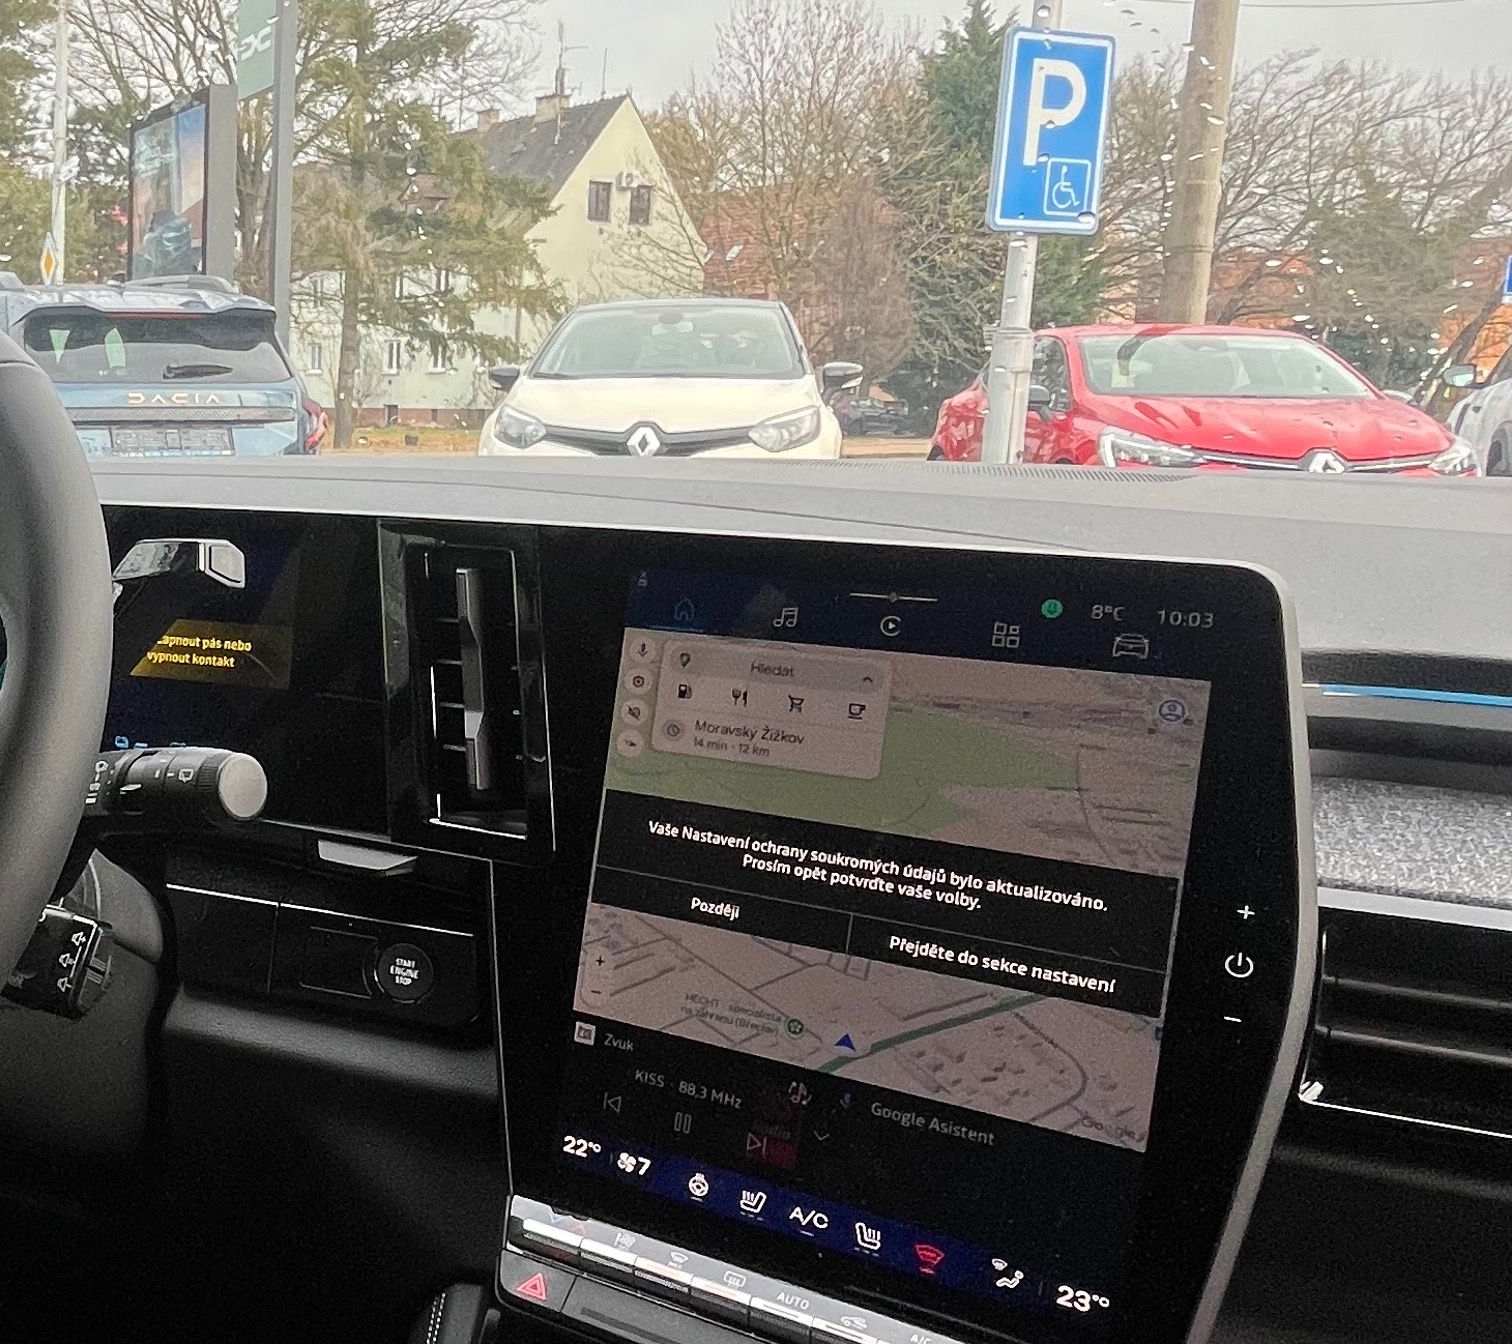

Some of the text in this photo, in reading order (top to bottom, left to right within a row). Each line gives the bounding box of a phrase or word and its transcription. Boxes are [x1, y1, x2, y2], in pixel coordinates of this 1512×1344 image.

[1023, 58, 1087, 166] P
[127, 392, 220, 405] DACIA
[1157, 608, 1214, 628] 10:03
[157, 634, 253, 653] apnout pás nebo
[146, 650, 236, 668] vypnout kontakt
[750, 661, 795, 678] Hledat
[752, 744, 770, 757] km
[648, 819, 1108, 912] Vaše Nastavení ochrany soukromých údajů bylo aktualizováno.
[742, 853, 982, 911] Prosím opět potvrďte vaše volby.
[690, 896, 740, 922] Později
[889, 934, 1117, 994] Přejděte do sekce nastavení
[603, 1032, 635, 1052] Zvuk
[634, 1068, 666, 1089] KISS
[710, 1088, 742, 1109] MHz
[870, 1101, 996, 1146] Google Asistent
[637, 1157, 652, 1176] 7
[789, 1206, 830, 1230] A/C
[776, 1291, 811, 1310] AUTO
